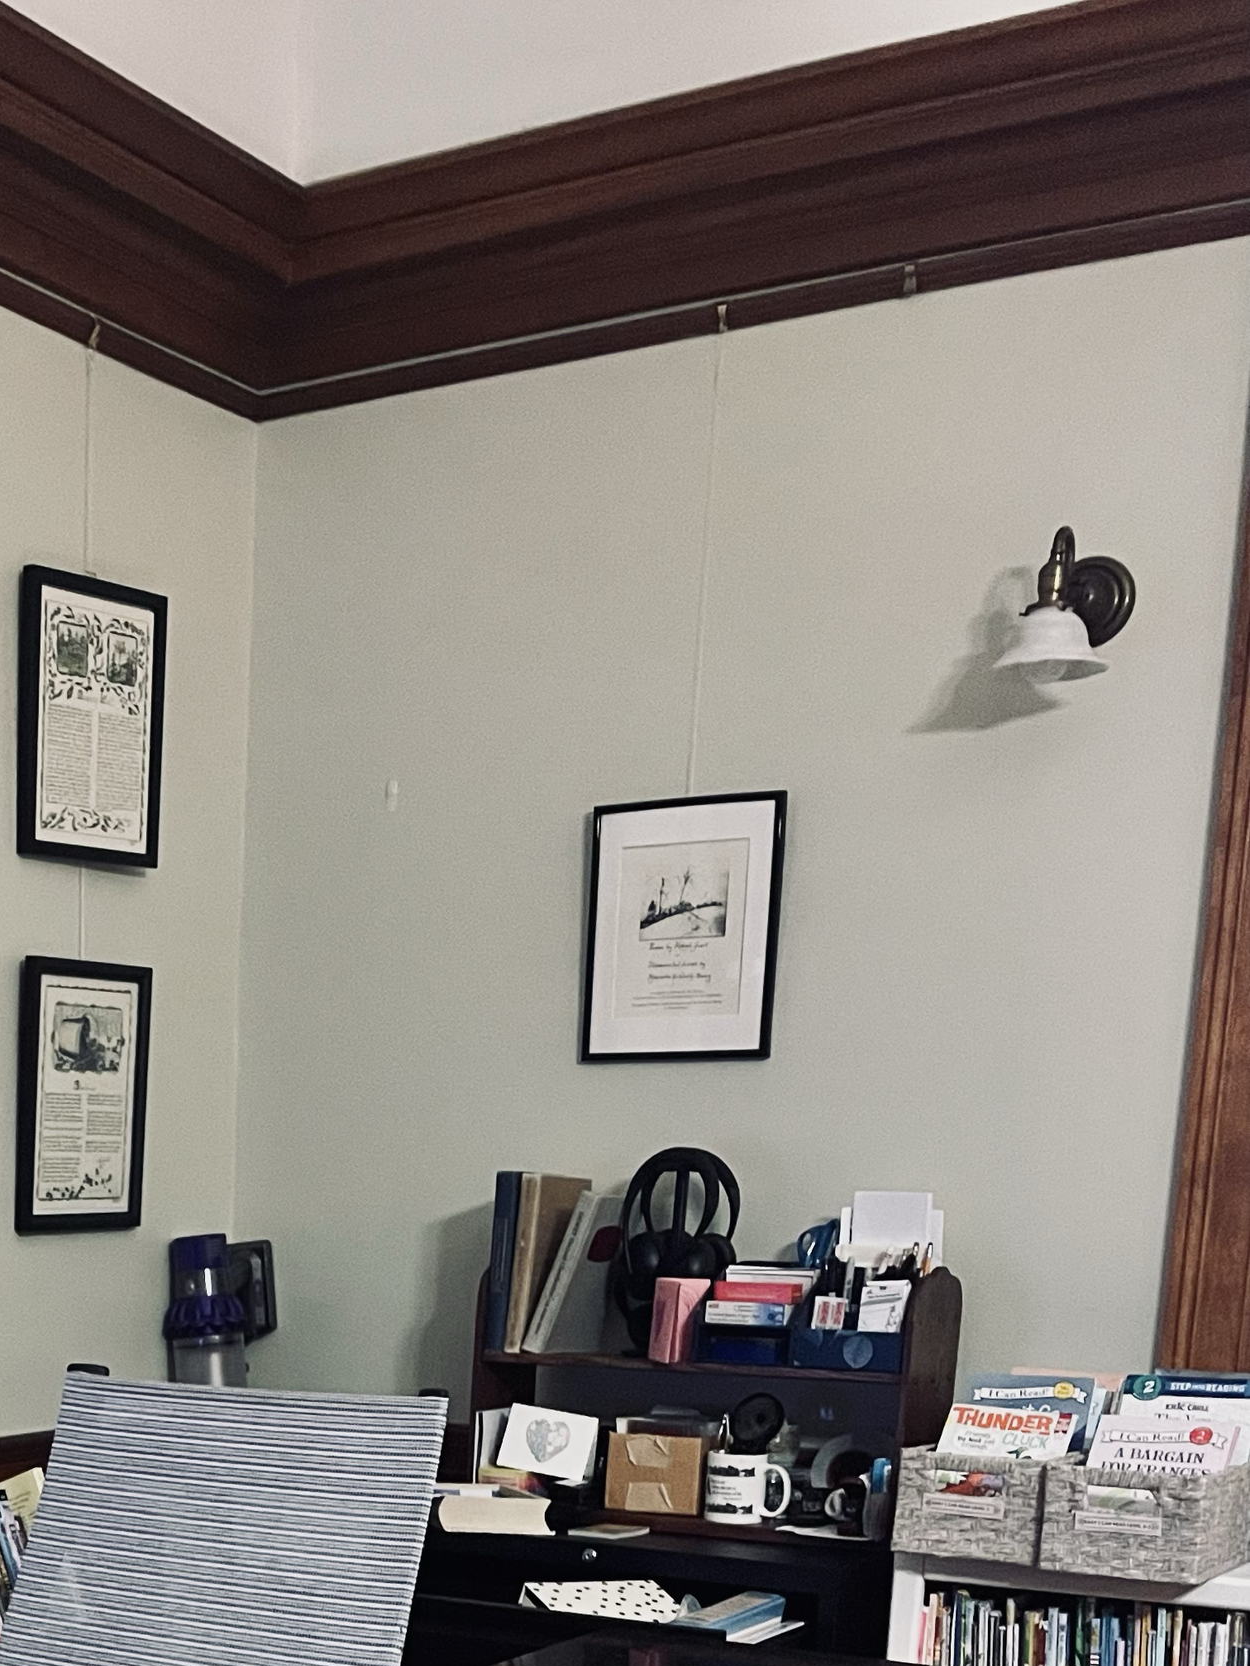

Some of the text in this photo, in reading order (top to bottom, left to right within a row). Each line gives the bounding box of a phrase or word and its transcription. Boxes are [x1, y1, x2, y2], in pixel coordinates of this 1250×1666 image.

[1143, 1381, 1155, 1393] 2
[1170, 1382, 1192, 1391] STEP
[1205, 1384, 1247, 1393] READING
[953, 1407, 1054, 1435] THUNDER
[1002, 1432, 1049, 1449] CLUCK
[1114, 1447, 1205, 1464] A BARGAIN
